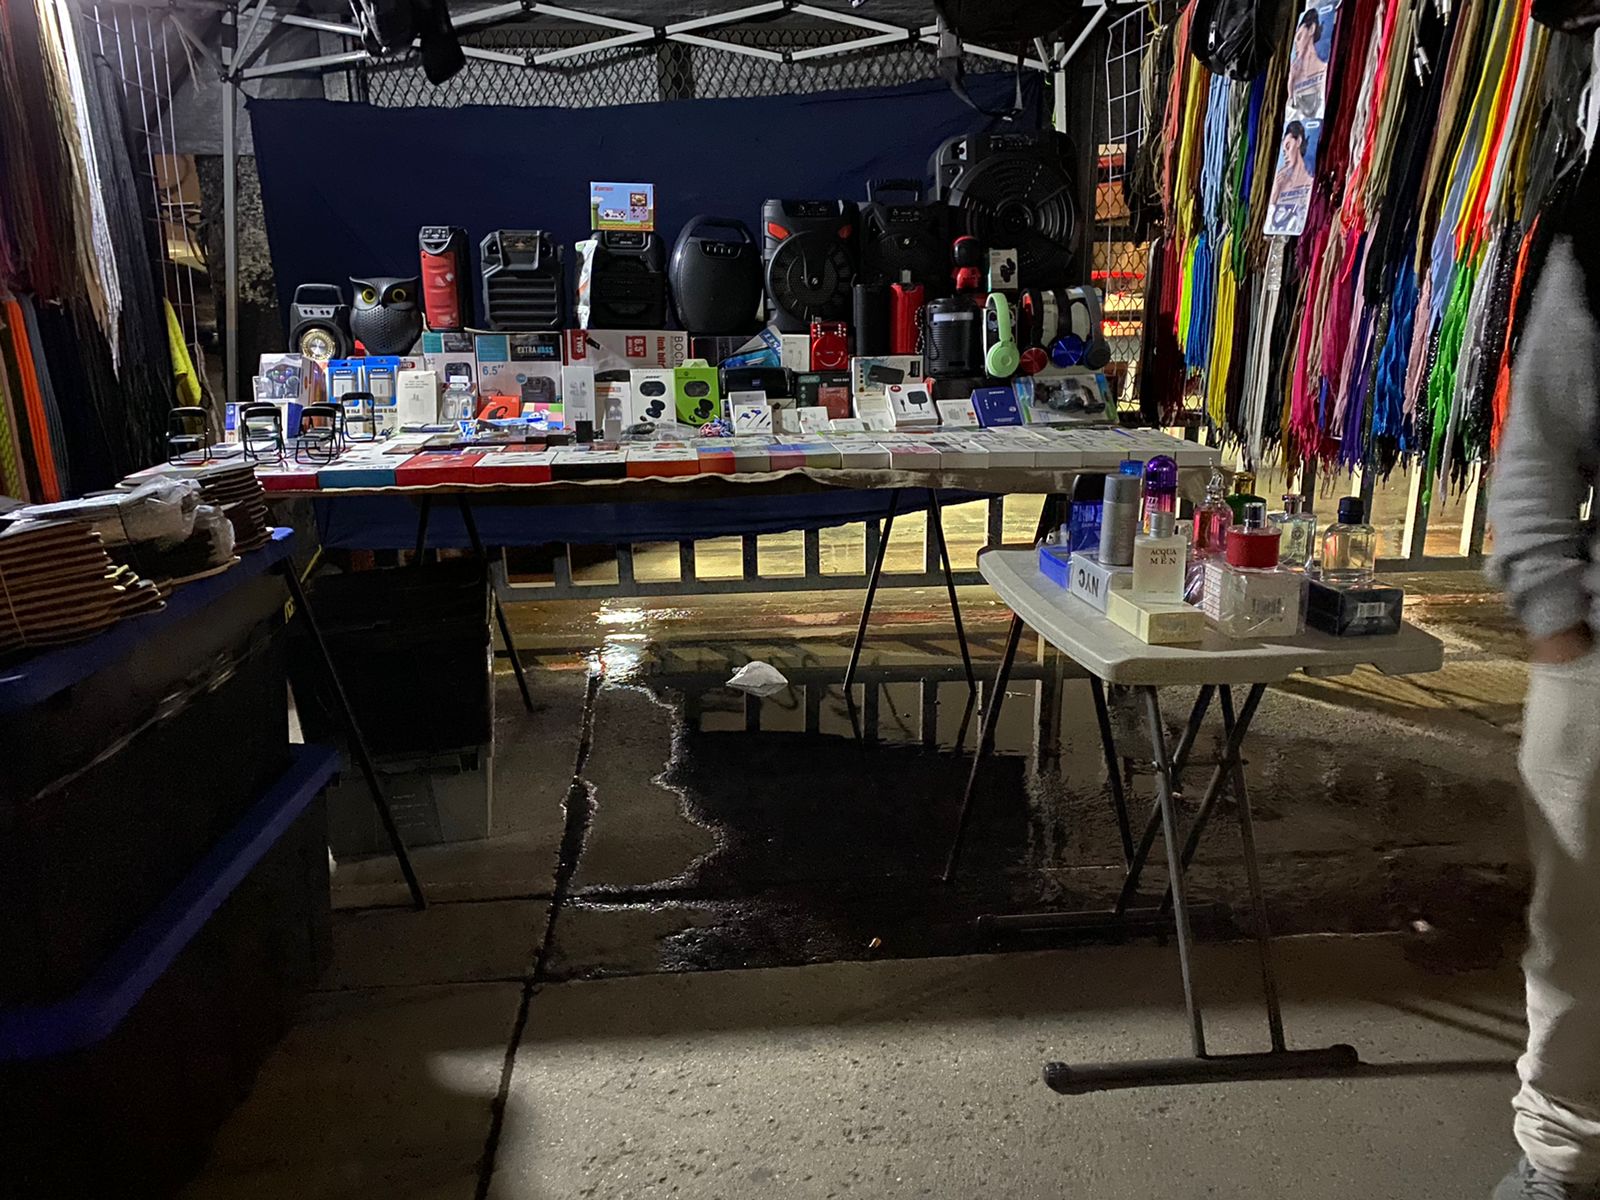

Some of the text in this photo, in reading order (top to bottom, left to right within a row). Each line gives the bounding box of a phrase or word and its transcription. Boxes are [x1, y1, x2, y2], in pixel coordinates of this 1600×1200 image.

[517, 346, 537, 354] EXTRA
[1150, 548, 1177, 557] ACQUA
[1078, 568, 1099, 598] NYC
